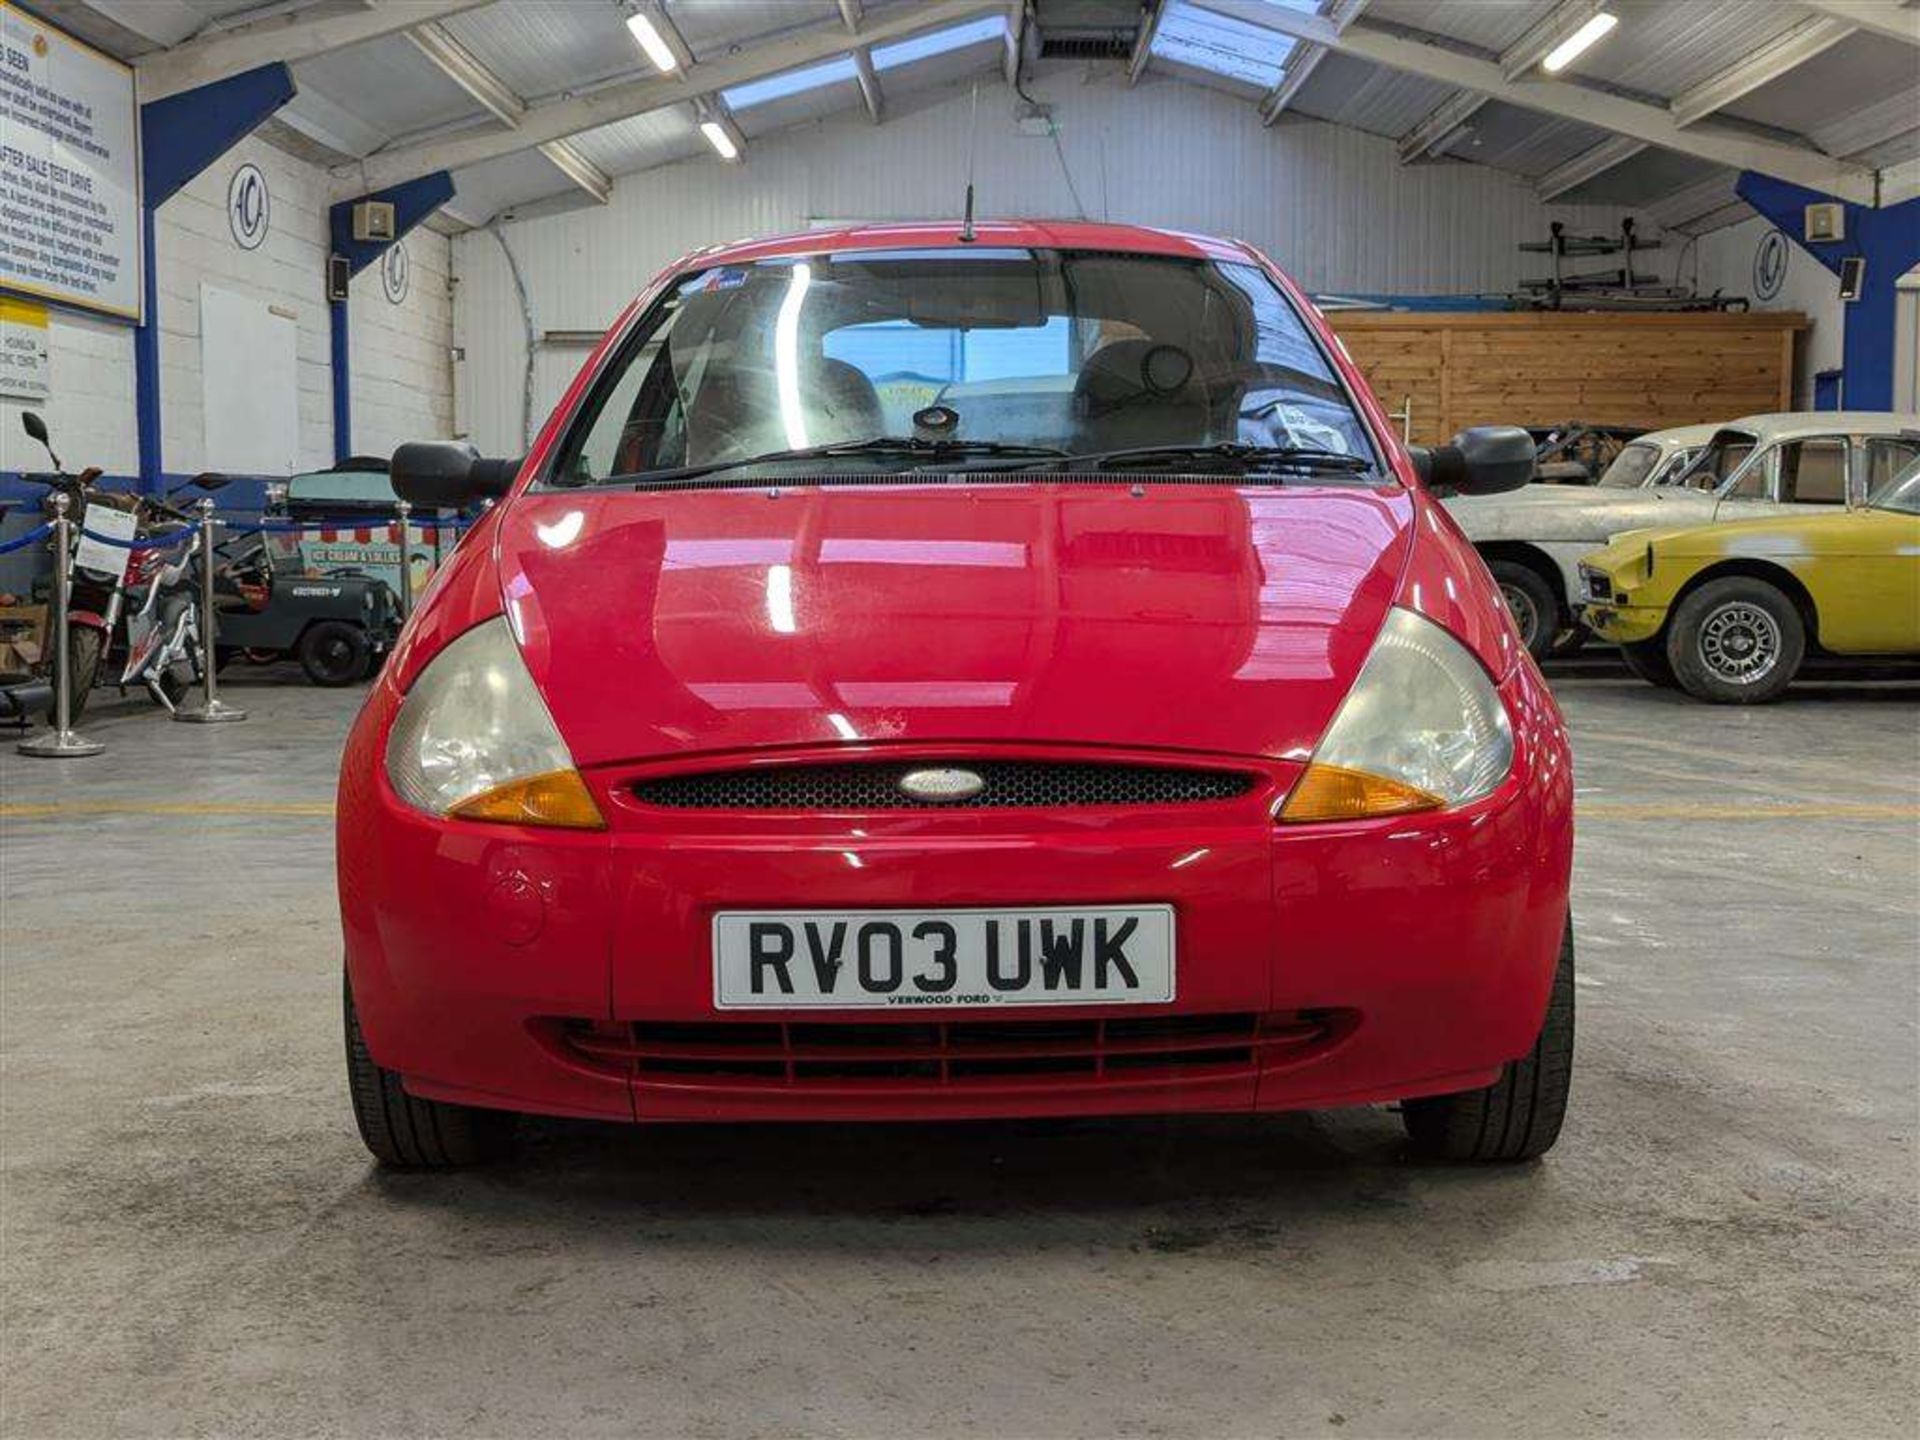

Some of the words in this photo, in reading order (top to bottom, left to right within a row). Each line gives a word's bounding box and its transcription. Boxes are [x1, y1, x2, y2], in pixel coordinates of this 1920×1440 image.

[7, 47, 28, 72] SEEN
[26, 155, 47, 178] SALE
[49, 163, 68, 185] TEST
[70, 171, 92, 194] DRIVE
[328, 551, 359, 562] CREAM
[749, 921, 957, 995] RV03
[986, 917, 1139, 990] UWK
[888, 994, 953, 1005] VERWOOD
[957, 994, 991, 1004] FORD
